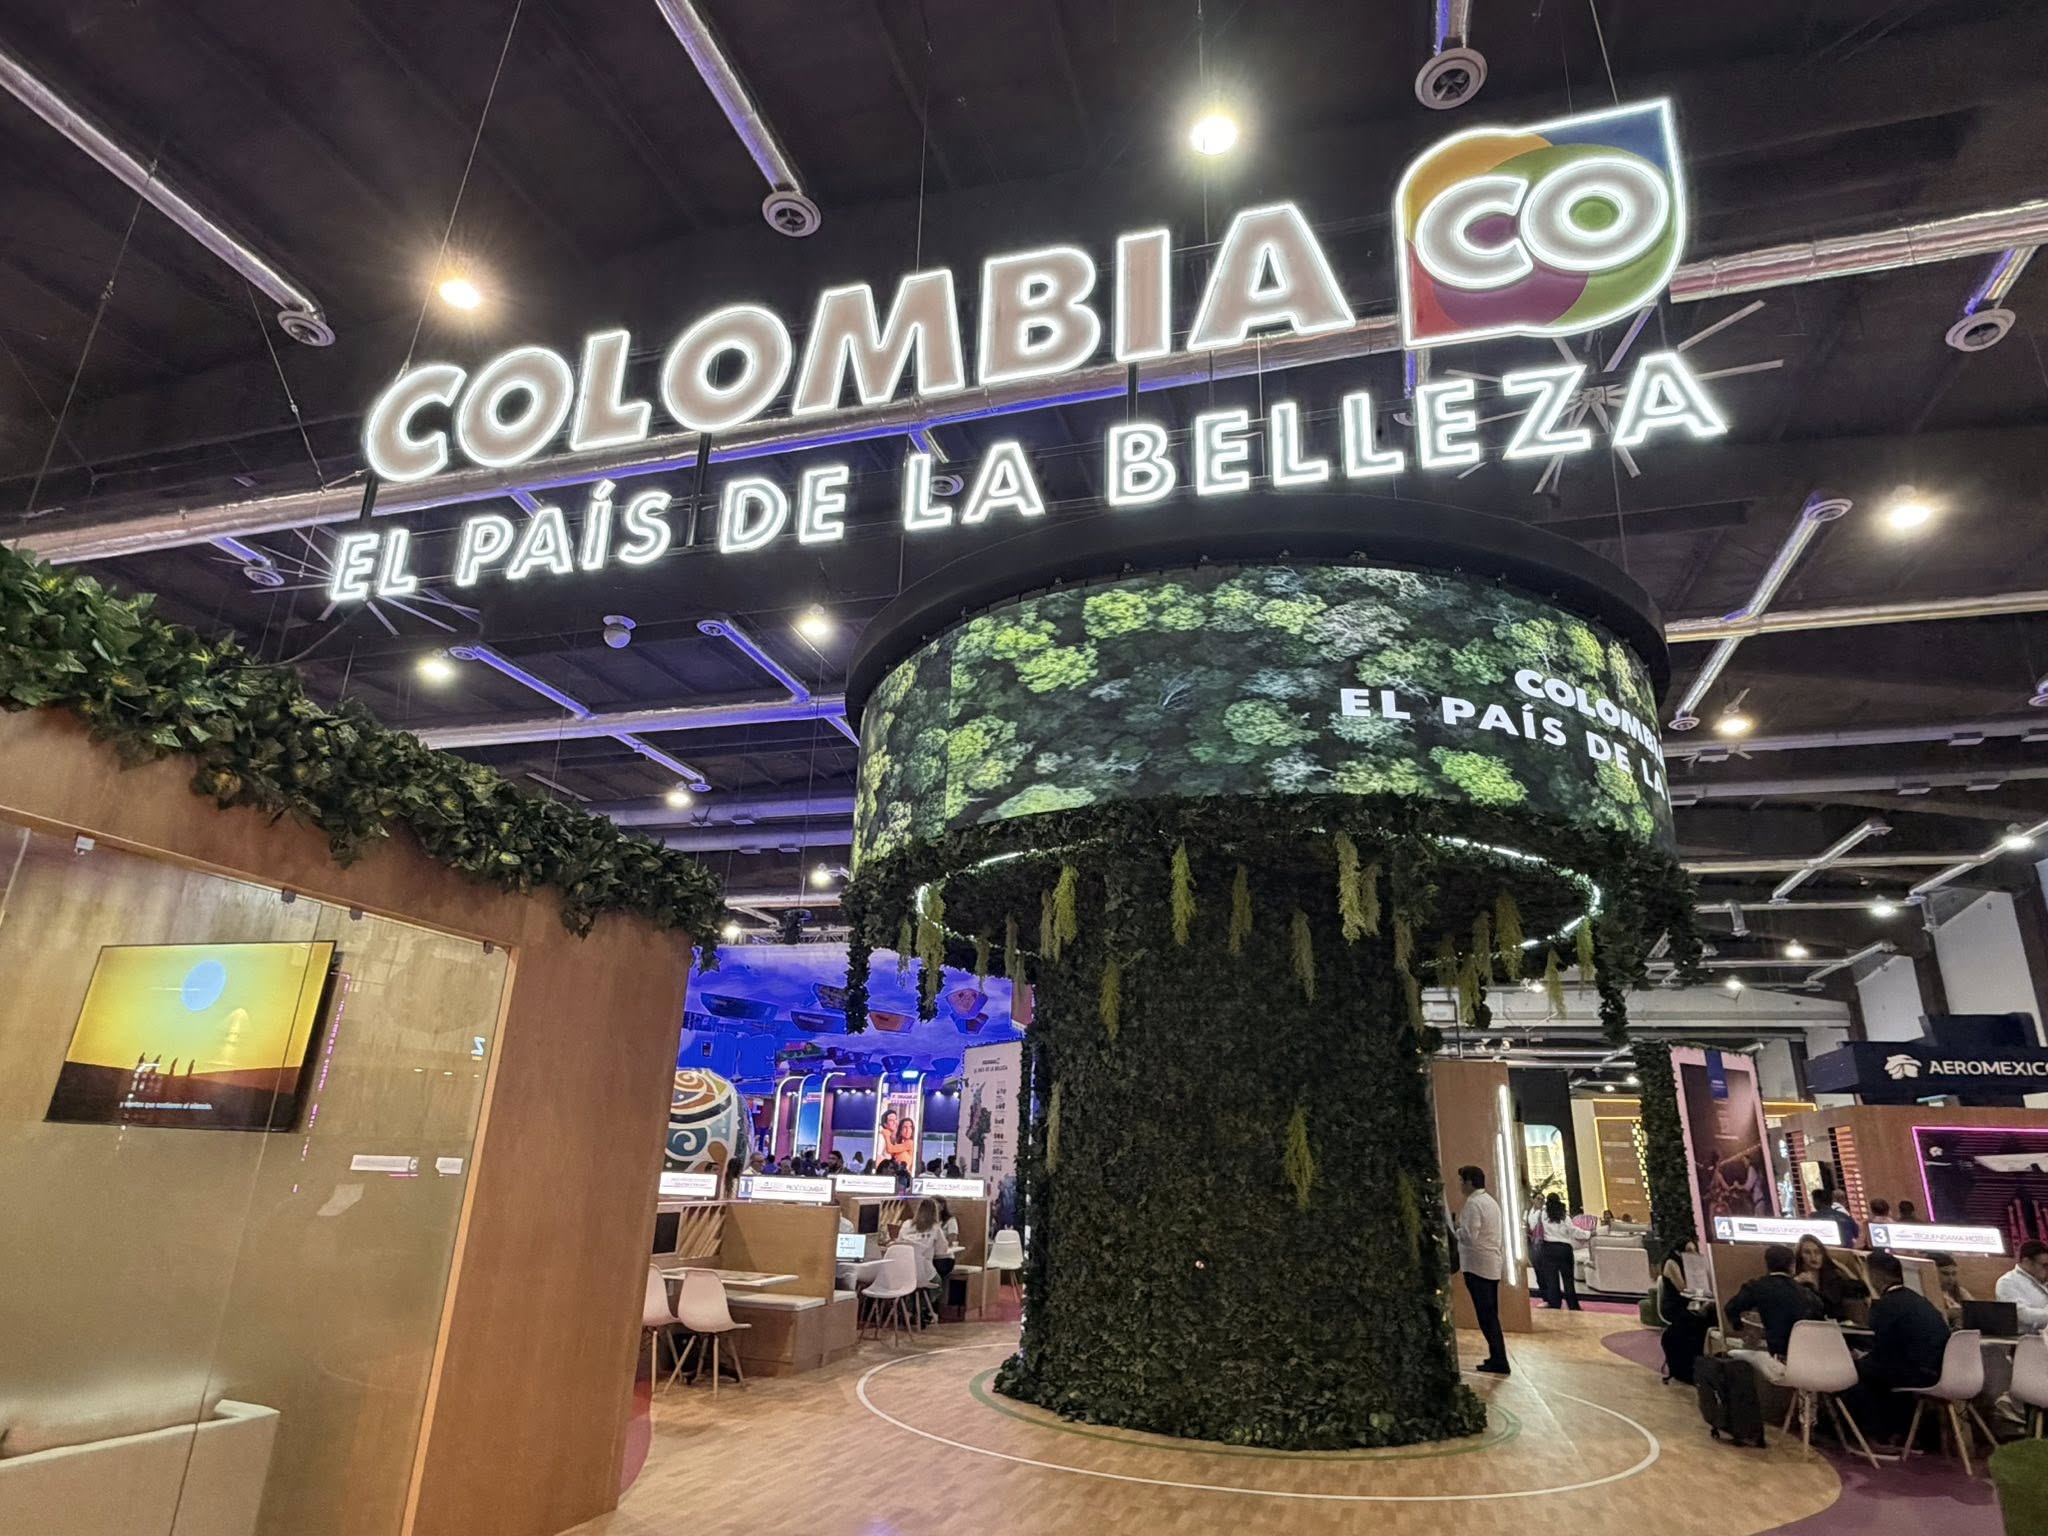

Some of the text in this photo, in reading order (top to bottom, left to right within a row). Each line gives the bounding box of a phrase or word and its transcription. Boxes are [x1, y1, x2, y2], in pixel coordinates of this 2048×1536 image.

[364, 155, 1671, 482] COLOMBIA CO
[329, 351, 1728, 602] EL PAÍS DE LA BELLEZA
[1340, 687, 1666, 801] EL PAÍS DE LA
[914, 1180, 923, 1192] 7
[1718, 1219, 1732, 1236] 4
[1872, 1227, 1888, 1244] 3
